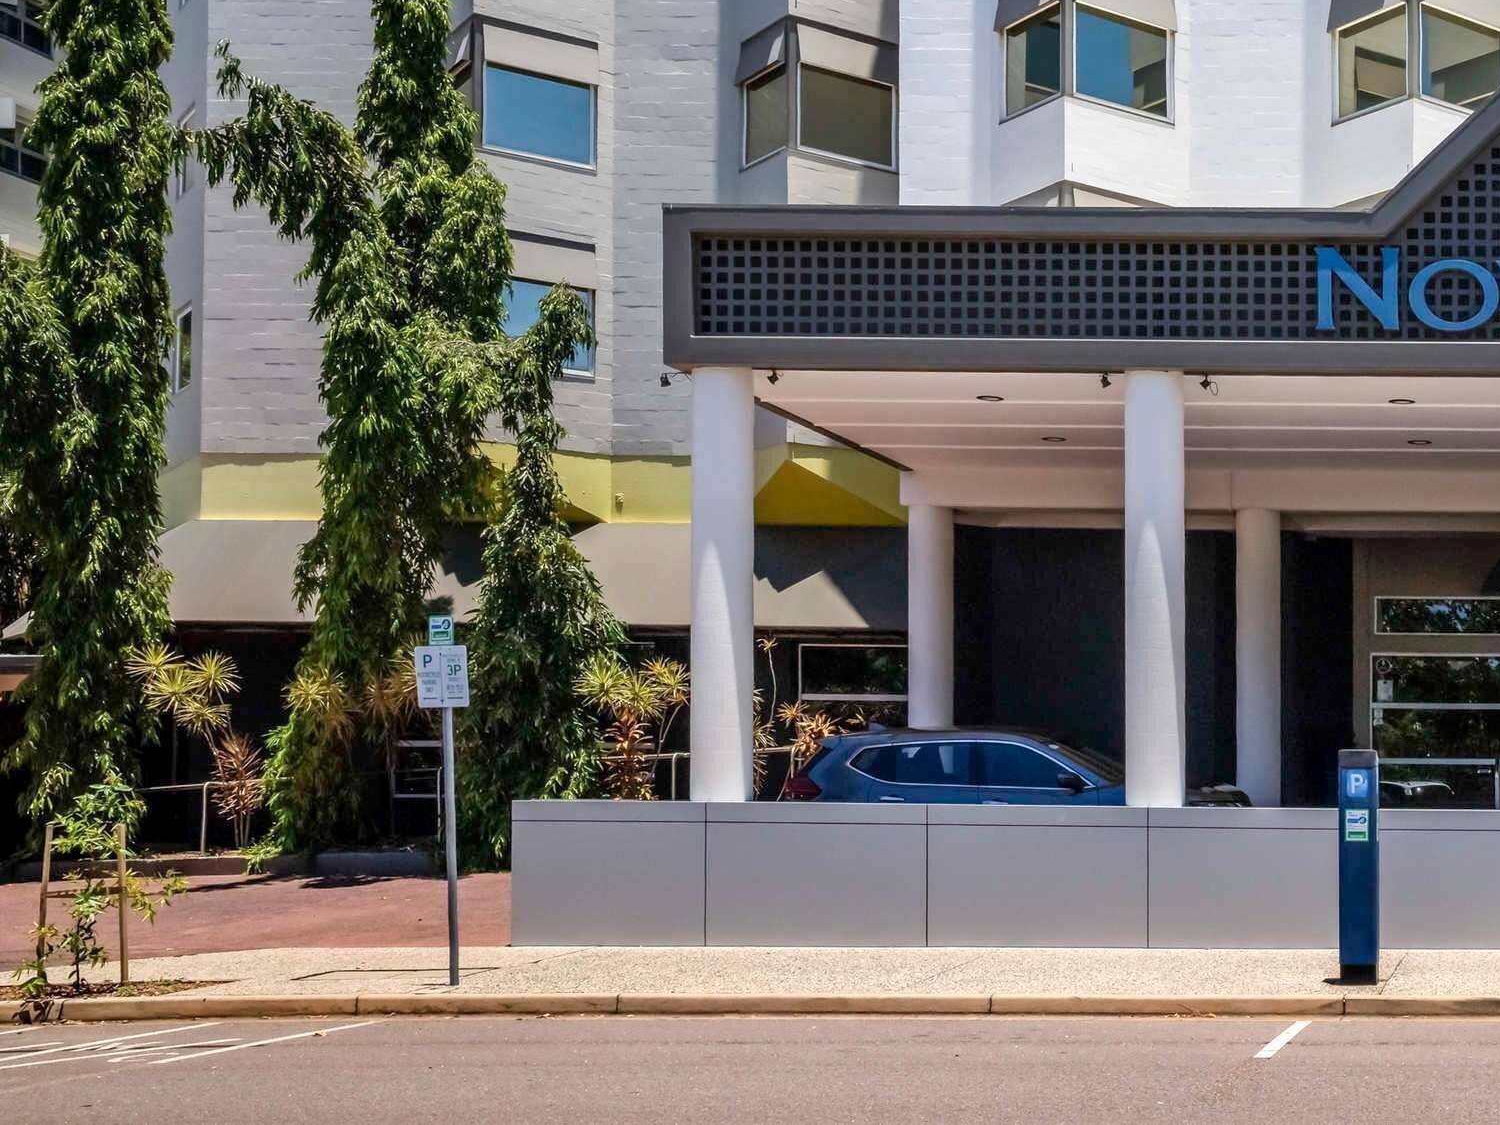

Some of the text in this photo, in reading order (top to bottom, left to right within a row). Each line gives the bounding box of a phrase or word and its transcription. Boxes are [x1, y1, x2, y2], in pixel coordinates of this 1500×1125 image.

[423, 654, 433, 668] P
[447, 664, 462, 676] 3P
[1350, 773, 1364, 794] P
